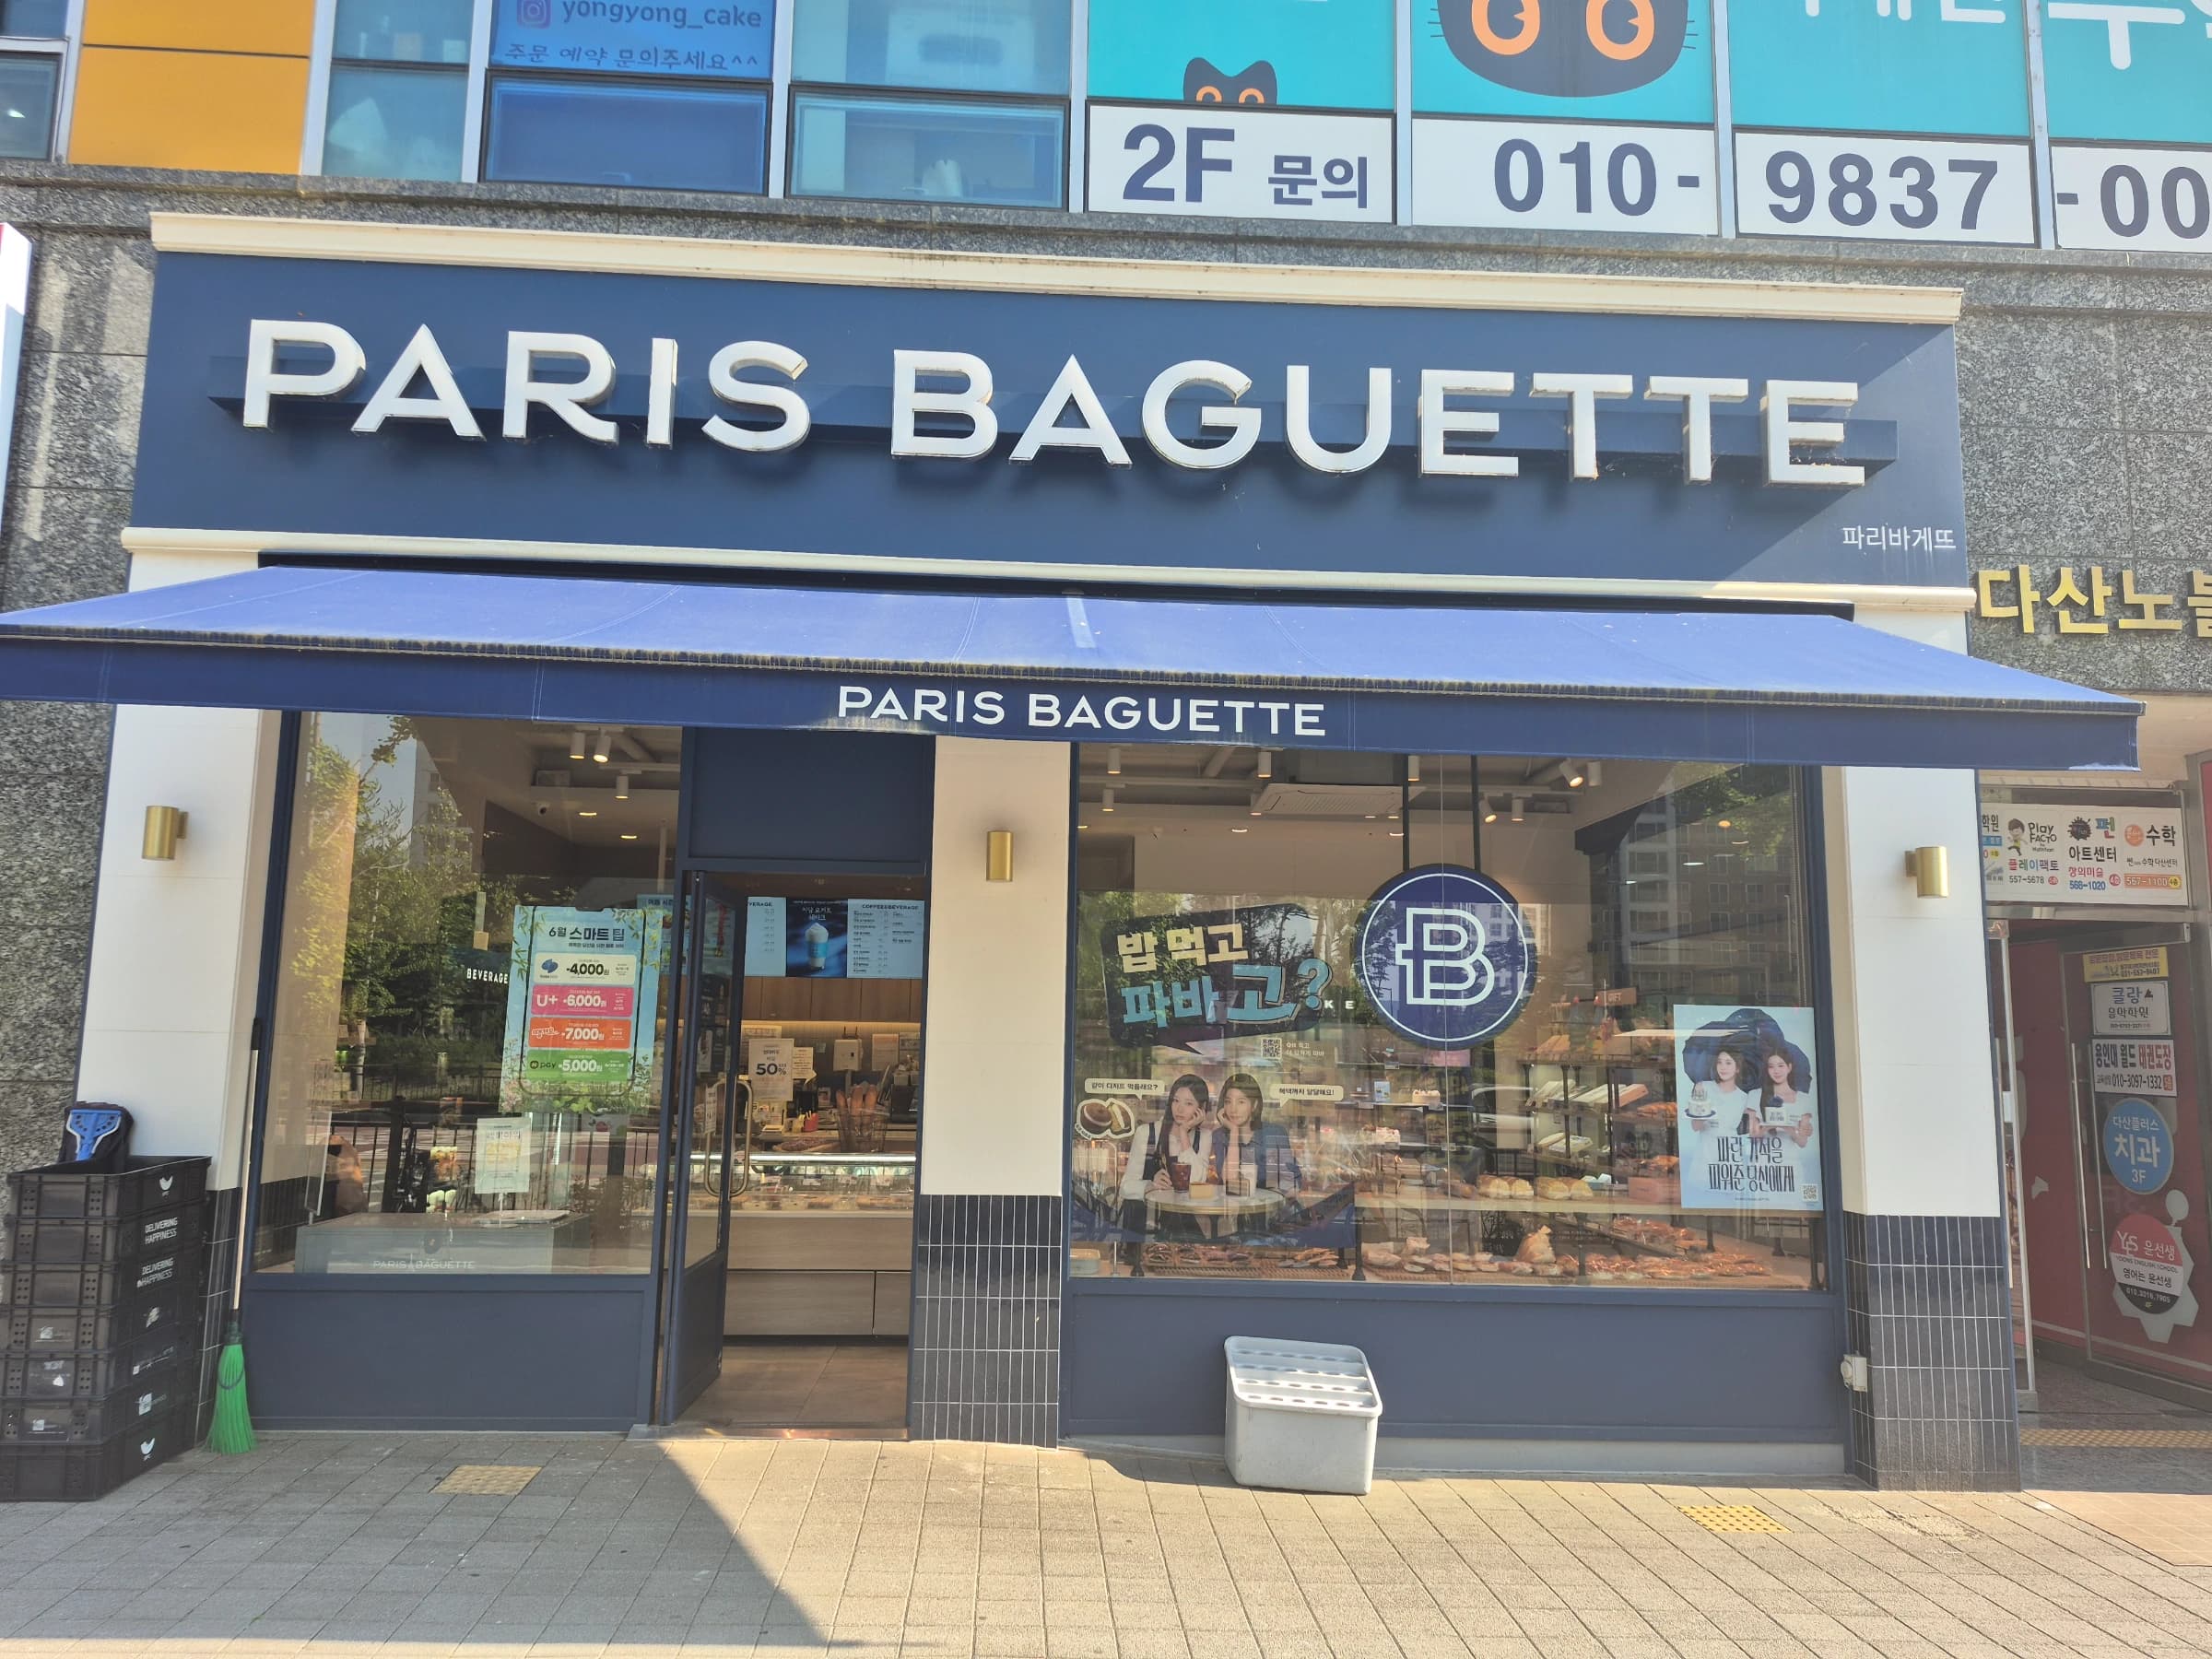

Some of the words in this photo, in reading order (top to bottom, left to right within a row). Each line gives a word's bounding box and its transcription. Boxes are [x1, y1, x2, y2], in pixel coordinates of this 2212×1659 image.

[562, 0, 762, 29] yongyong_cake
[505, 44, 550, 63] 주문
[559, 46, 608, 65] 예약
[1123, 123, 1236, 204] 2F
[1267, 154, 1369, 209] 문의
[1765, 149, 1998, 231] 9837
[243, 319, 811, 453] PARIS
[890, 348, 1865, 488] BAGUETTE
[1842, 525, 1958, 551] 파리바게뜨
[838, 685, 1005, 726] PARIS
[1028, 693, 1326, 737] BAGUETTE
[2028, 821, 2054, 836] Play
[2146, 824, 2176, 847] 수학
[2030, 832, 2057, 844] FACTO
[2068, 845, 2117, 863] 아트센터
[2008, 858, 2059, 872] 플레이팩토
[569, 927, 609, 941] 스마트
[1166, 923, 1249, 966] 먹고
[466, 968, 509, 984] BEVERAGE
[536, 994, 559, 1007] U+
[2112, 1116, 2160, 1132] 다산플러스
[2113, 1134, 2160, 1168] 치과
[2131, 1169, 2147, 1184] 3F
[145, 1217, 178, 1233] DELIVERING
[145, 1228, 178, 1244] HAPPINESS
[2144, 1240, 2175, 1261] 윤선생
[142, 1257, 174, 1275] DELIVERING
[373, 1260, 406, 1269] PARIS
[415, 1260, 474, 1269] BAGUETTE
[2148, 1273, 2172, 1288] 윤선생
